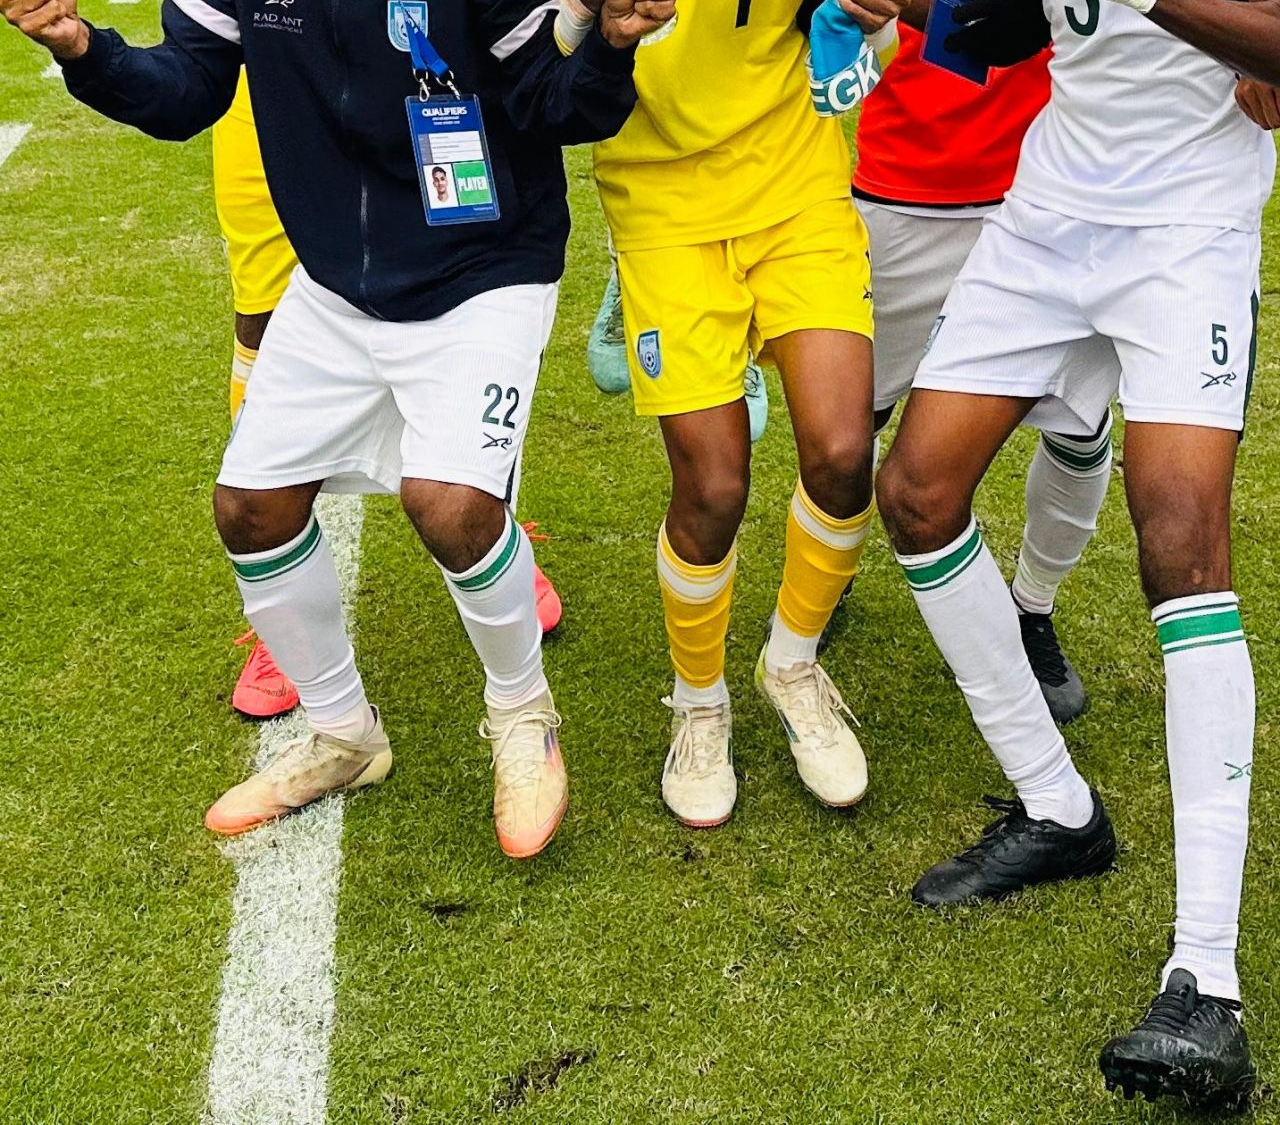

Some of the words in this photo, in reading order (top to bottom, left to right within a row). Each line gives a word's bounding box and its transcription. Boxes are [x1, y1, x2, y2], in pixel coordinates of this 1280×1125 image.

[253, 12, 304, 27] RADANT
[421, 106, 468, 117] QUALIFIERS
[1211, 323, 1229, 366] 5
[481, 383, 520, 429] 22
